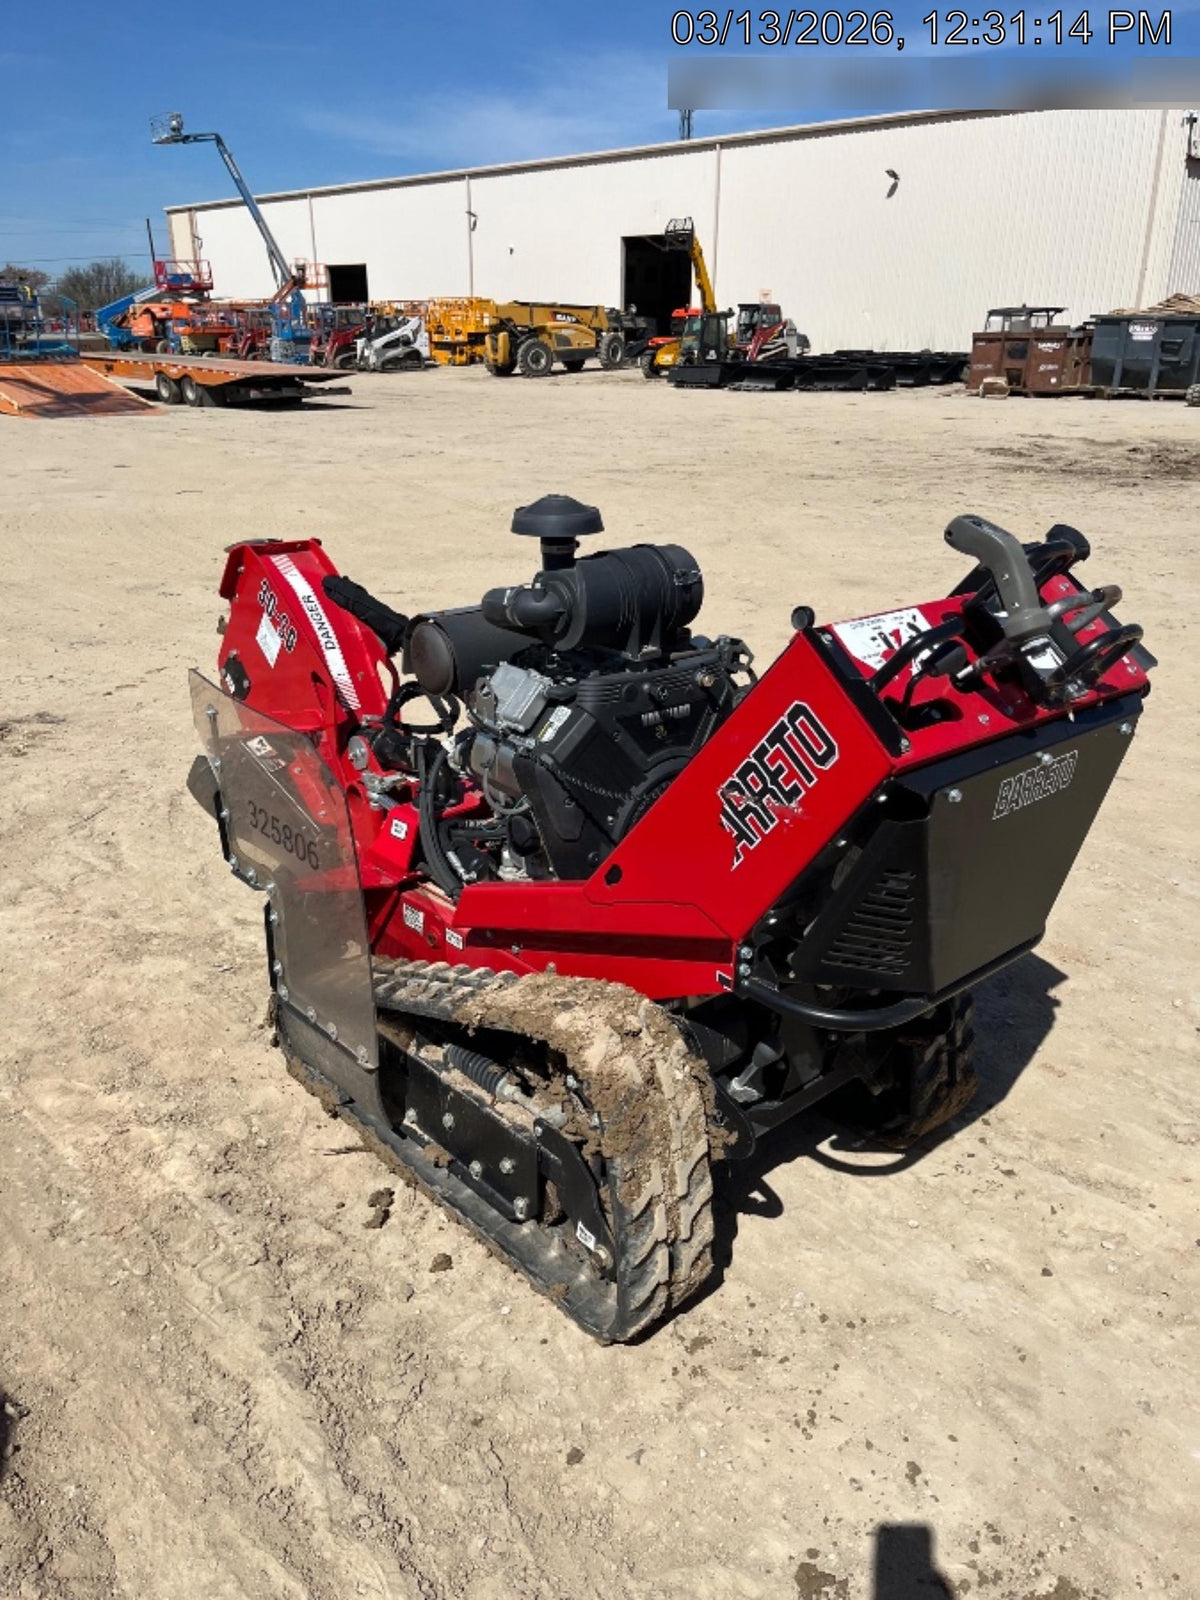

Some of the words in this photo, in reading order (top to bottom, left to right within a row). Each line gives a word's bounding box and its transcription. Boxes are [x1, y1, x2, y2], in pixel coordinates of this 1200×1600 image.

[302, 594, 336, 650] DANGER
[992, 749, 1078, 820] BARRETO
[248, 800, 319, 870] 325806
